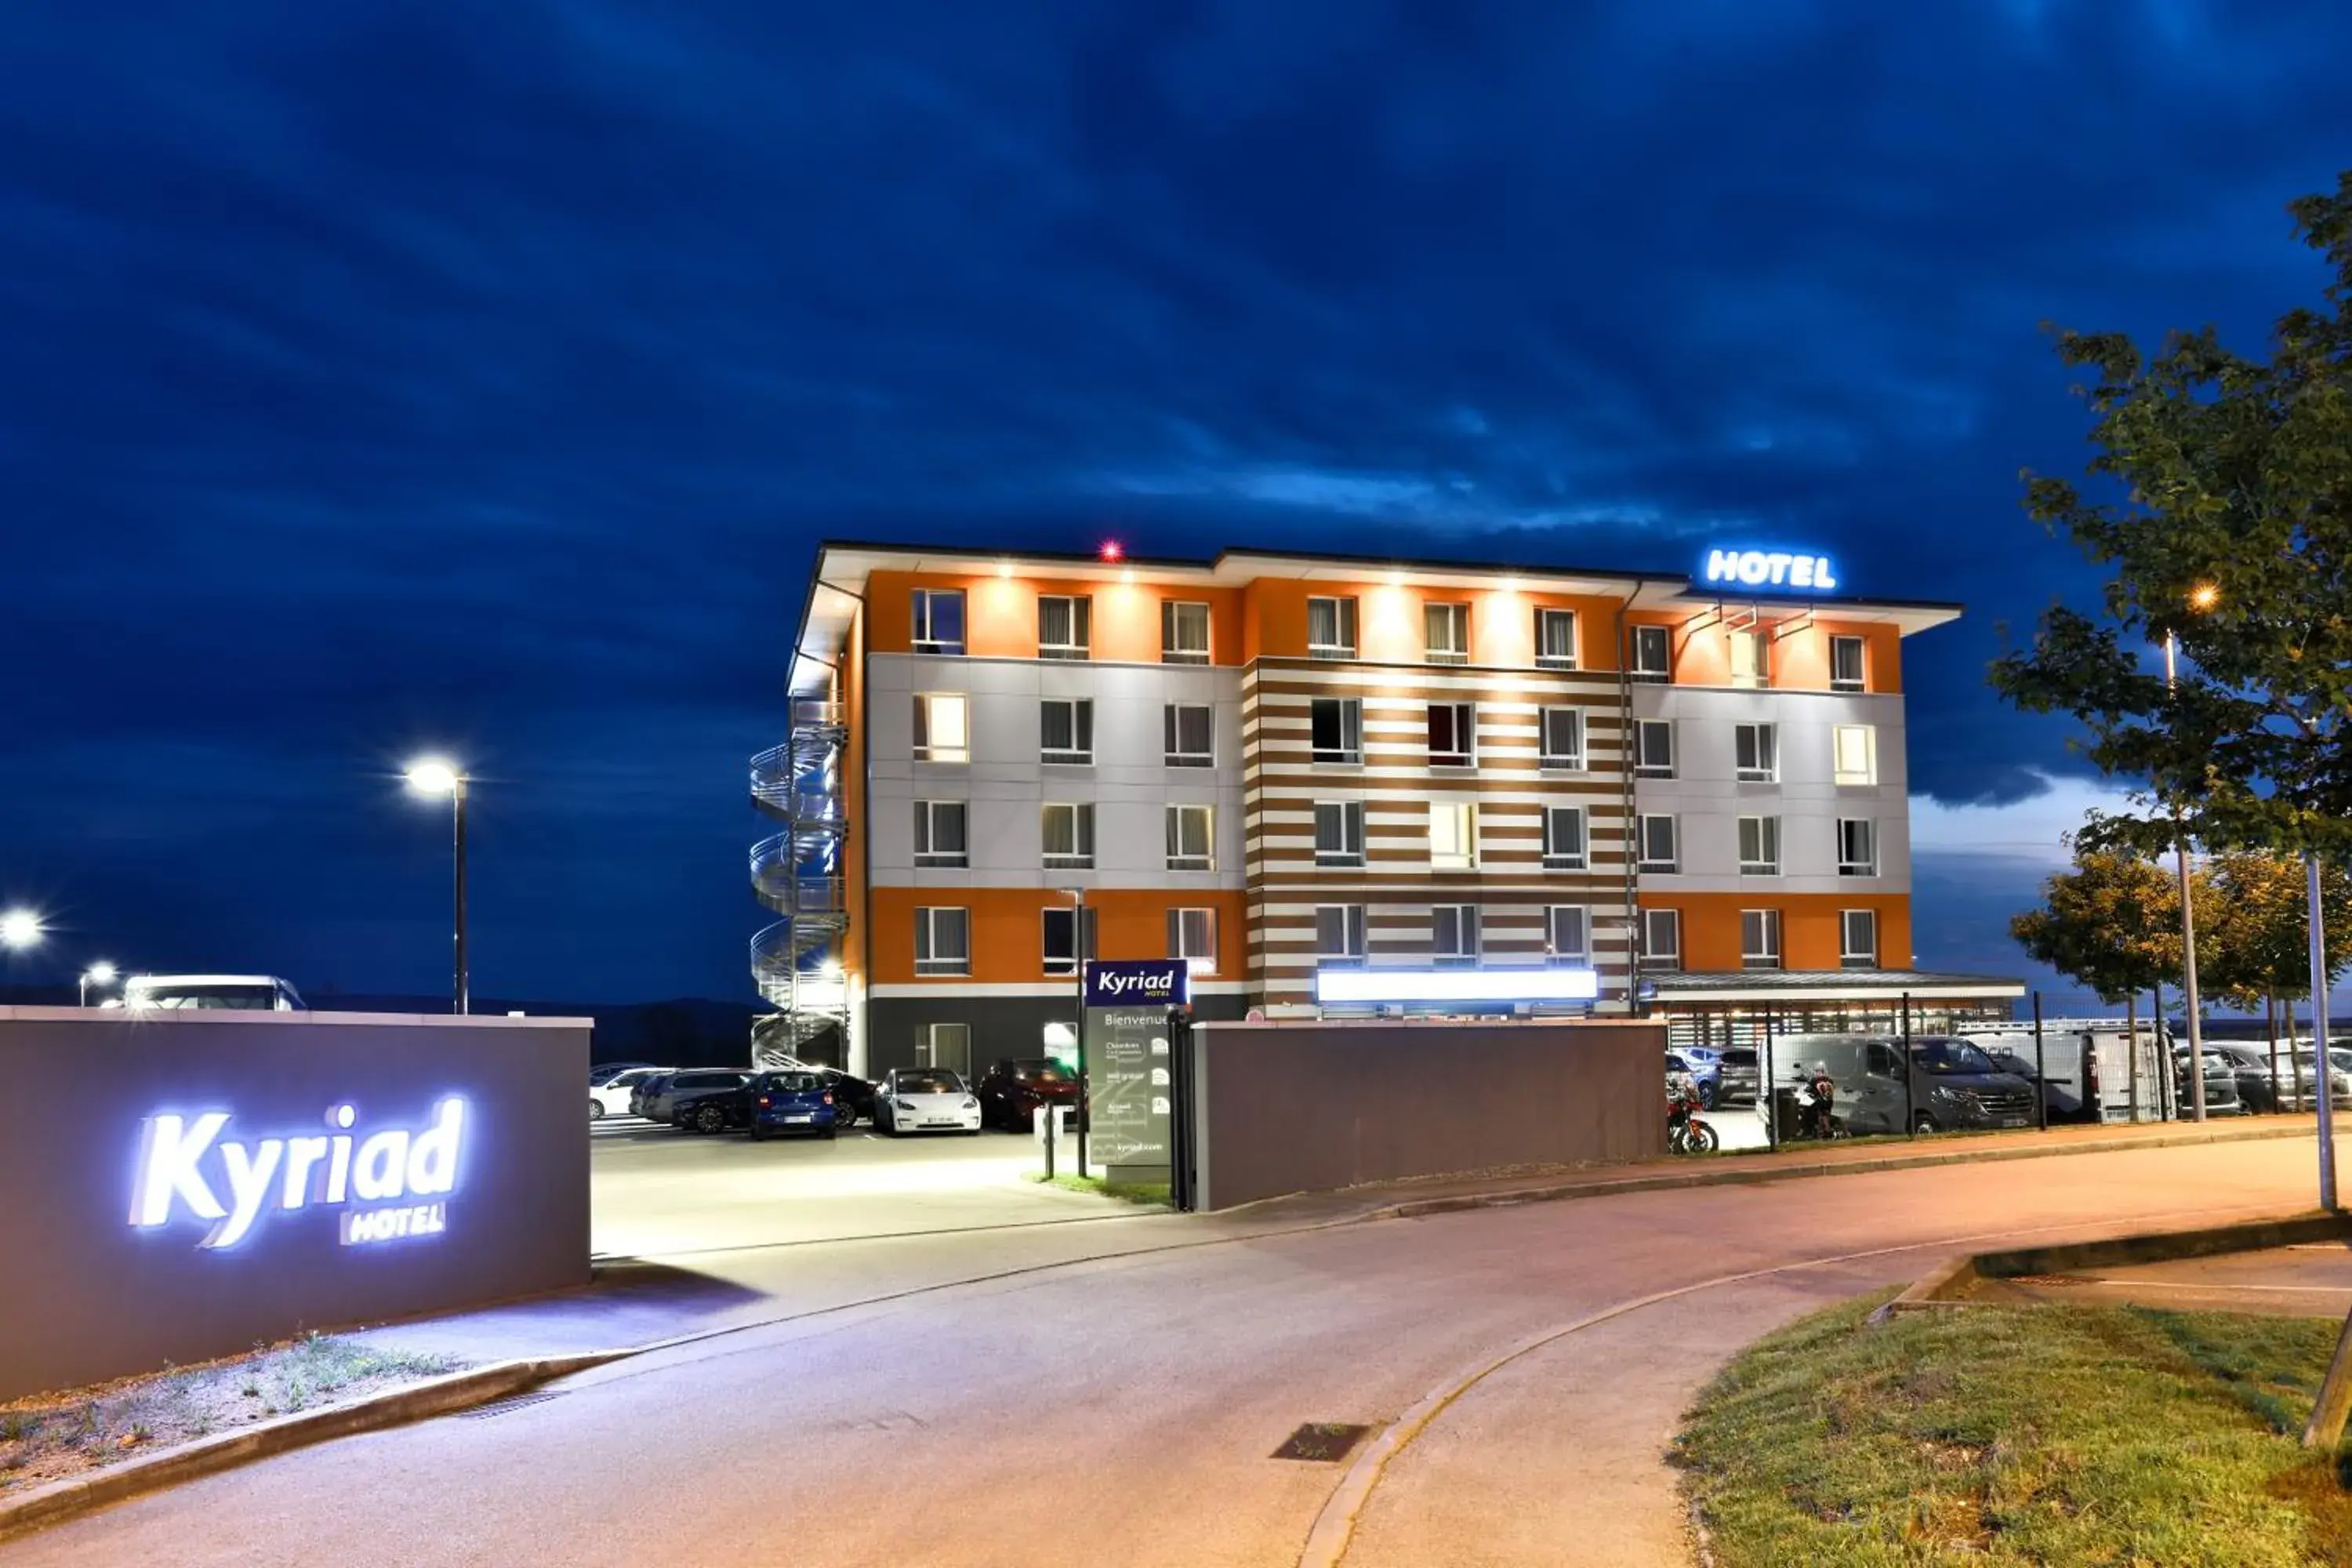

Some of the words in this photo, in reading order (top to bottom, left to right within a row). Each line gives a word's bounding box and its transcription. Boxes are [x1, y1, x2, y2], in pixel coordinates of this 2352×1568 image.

[1707, 550, 1835, 588] HOTEL
[1098, 970, 1174, 995] Kyriad
[1105, 1014, 1168, 1025] Bienvenue
[1117, 1142, 1163, 1152] kyriad.com
[130, 1098, 463, 1249] Kyriad
[350, 1208, 444, 1243] HOTEL
